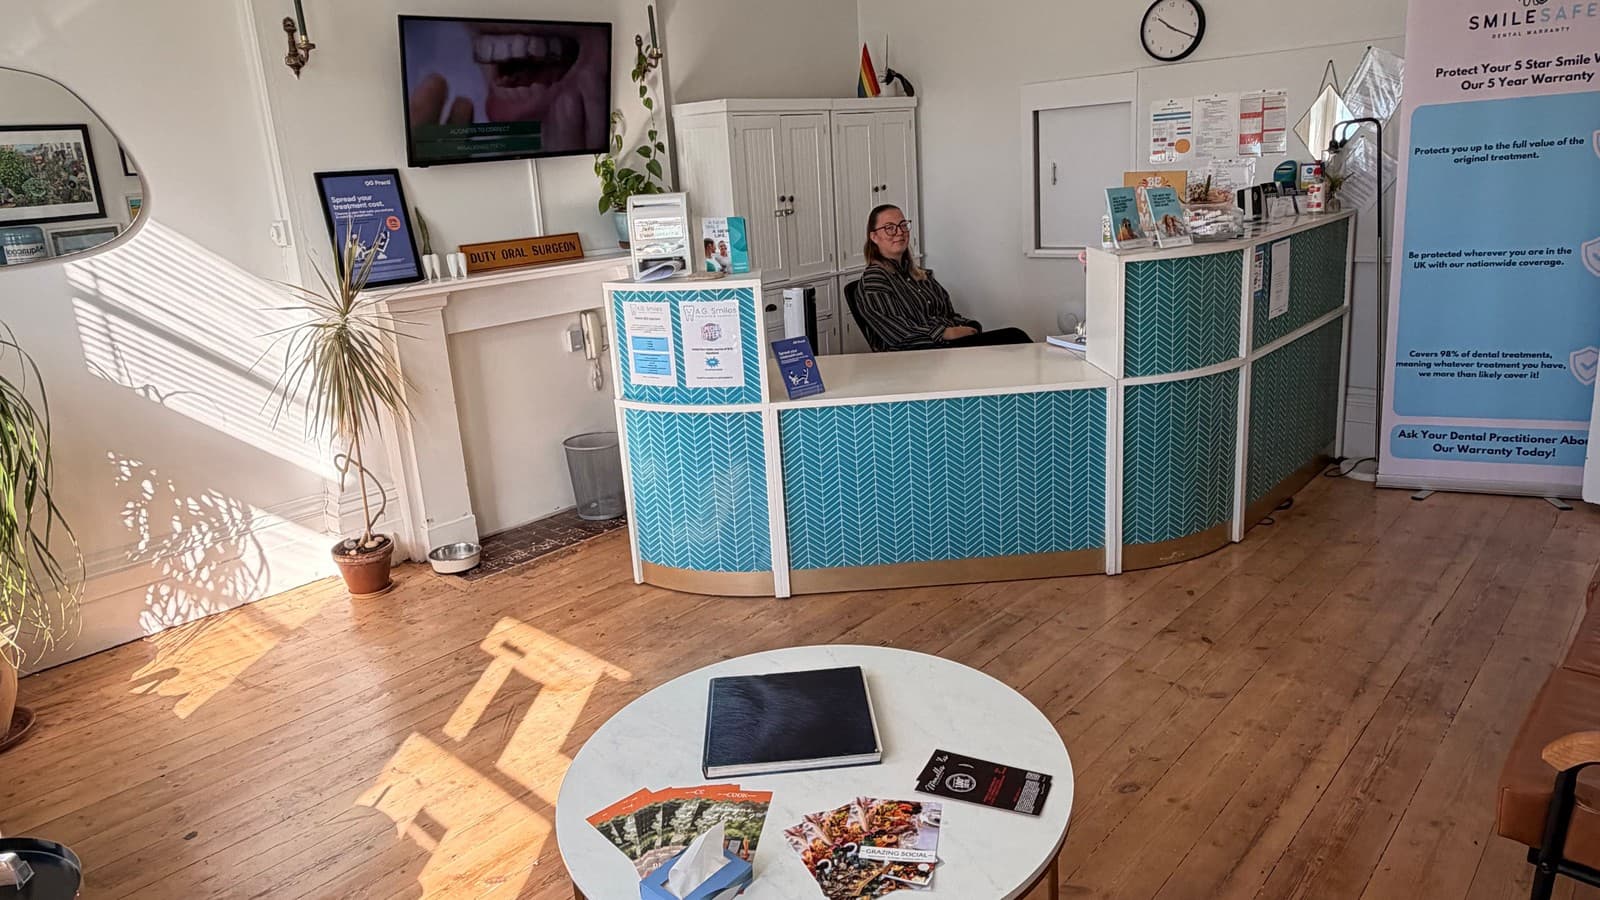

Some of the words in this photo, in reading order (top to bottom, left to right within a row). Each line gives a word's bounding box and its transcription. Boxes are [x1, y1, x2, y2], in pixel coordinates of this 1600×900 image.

[1492, 31, 1522, 39] DENTAL
[1526, 26, 1571, 35] WARRANTY
[1435, 65, 1478, 78] Protect
[1481, 63, 1511, 74] Your
[1514, 60, 1522, 71] 5
[1525, 59, 1552, 70] Star
[1555, 54, 1591, 67] Smile
[1461, 80, 1484, 90] Our
[1487, 79, 1495, 89] 5
[1498, 77, 1528, 87] Year
[1531, 71, 1595, 84] Warranty
[1414, 147, 1450, 155] Protects
[1451, 147, 1469, 155] you
[1495, 142, 1511, 150] the
[1513, 140, 1527, 149] full
[1529, 140, 1555, 148] value
[1557, 138, 1568, 146] of
[1569, 137, 1585, 145] the
[1453, 154, 1489, 165] original
[1490, 152, 1540, 161] treatment.
[331, 195, 357, 205] Spread
[357, 195, 372, 203] your
[333, 202, 367, 210] treatment
[469, 250, 497, 264] DUTY
[501, 247, 528, 260] ORAL
[531, 241, 577, 256] SURGEON
[1420, 250, 1462, 260] protected
[1463, 249, 1507, 258] wherever
[1508, 249, 1526, 258] you
[1545, 248, 1555, 256] in
[1557, 247, 1572, 255] the
[1428, 261, 1447, 269] with
[1449, 261, 1464, 269] our
[1466, 259, 1517, 268] nationwide
[1518, 259, 1565, 268] coverage.
[711, 305, 737, 314] Smiles
[1409, 350, 1438, 358] Covers
[1440, 350, 1459, 358] 98%
[1461, 350, 1470, 358] of
[1472, 350, 1500, 358] dental
[1395, 361, 1432, 369] meaning
[1433, 361, 1474, 369] whatever
[1476, 361, 1521, 369] treatment
[1522, 362, 1539, 370] you
[1457, 370, 1477, 378] than
[1478, 371, 1502, 380] likely
[1530, 371, 1540, 379] it!
[1398, 430, 1418, 439] Ask
[1420, 430, 1448, 440] Your
[1450, 432, 1486, 442] Dental
[1489, 433, 1558, 445] Practitioner
[1432, 444, 1454, 453] Our
[1456, 445, 1513, 458] Warranty
[1515, 447, 1556, 459] Today!
[865, 848, 900, 857] GRAZING
[900, 851, 929, 859] SOCIAL
